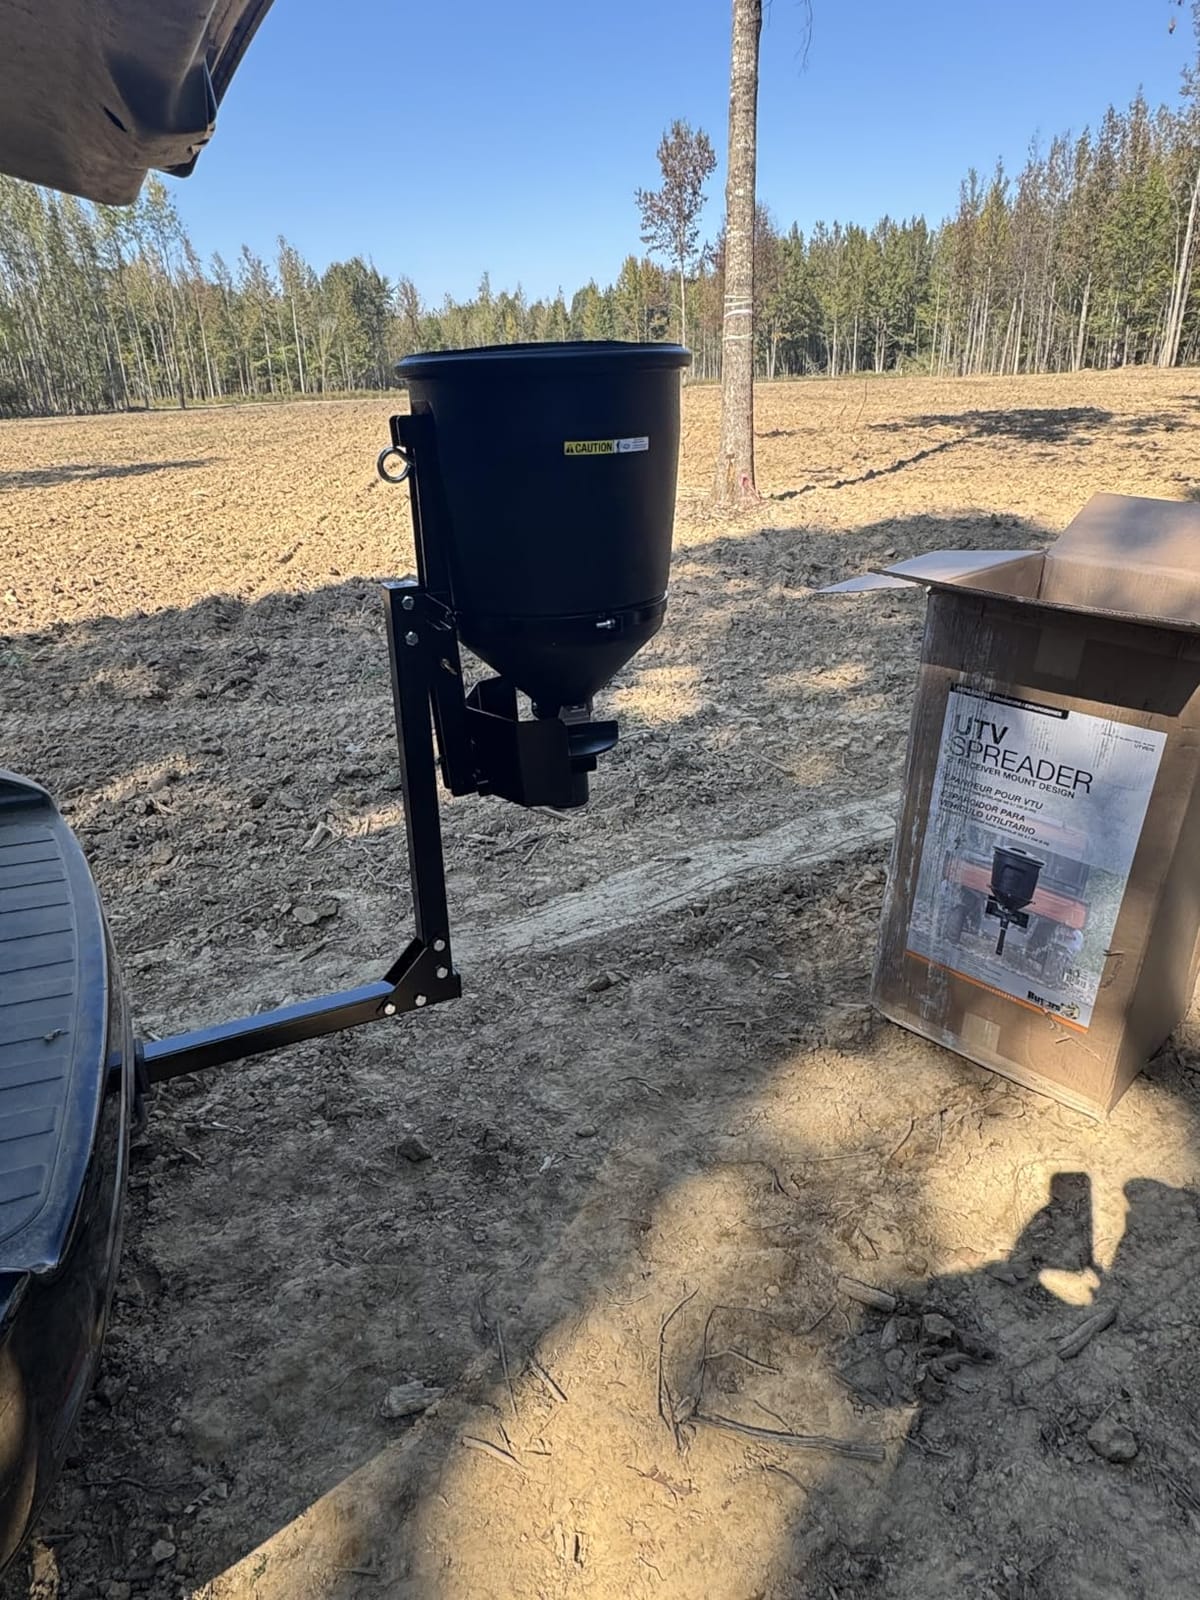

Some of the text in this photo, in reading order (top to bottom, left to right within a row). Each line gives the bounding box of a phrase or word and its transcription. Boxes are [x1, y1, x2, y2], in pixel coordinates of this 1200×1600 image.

[575, 442, 613, 454] CAUTION
[955, 714, 1010, 746] UTV
[950, 736, 1094, 794] SPREADER
[1002, 772, 1037, 787] MOUNT
[1038, 782, 1076, 799] DESIGN
[994, 789, 1022, 803] POUR
[1024, 798, 1044, 810] VTU
[985, 813, 1036, 836] UTILITARIO
[1000, 808, 1026, 822] PARA
